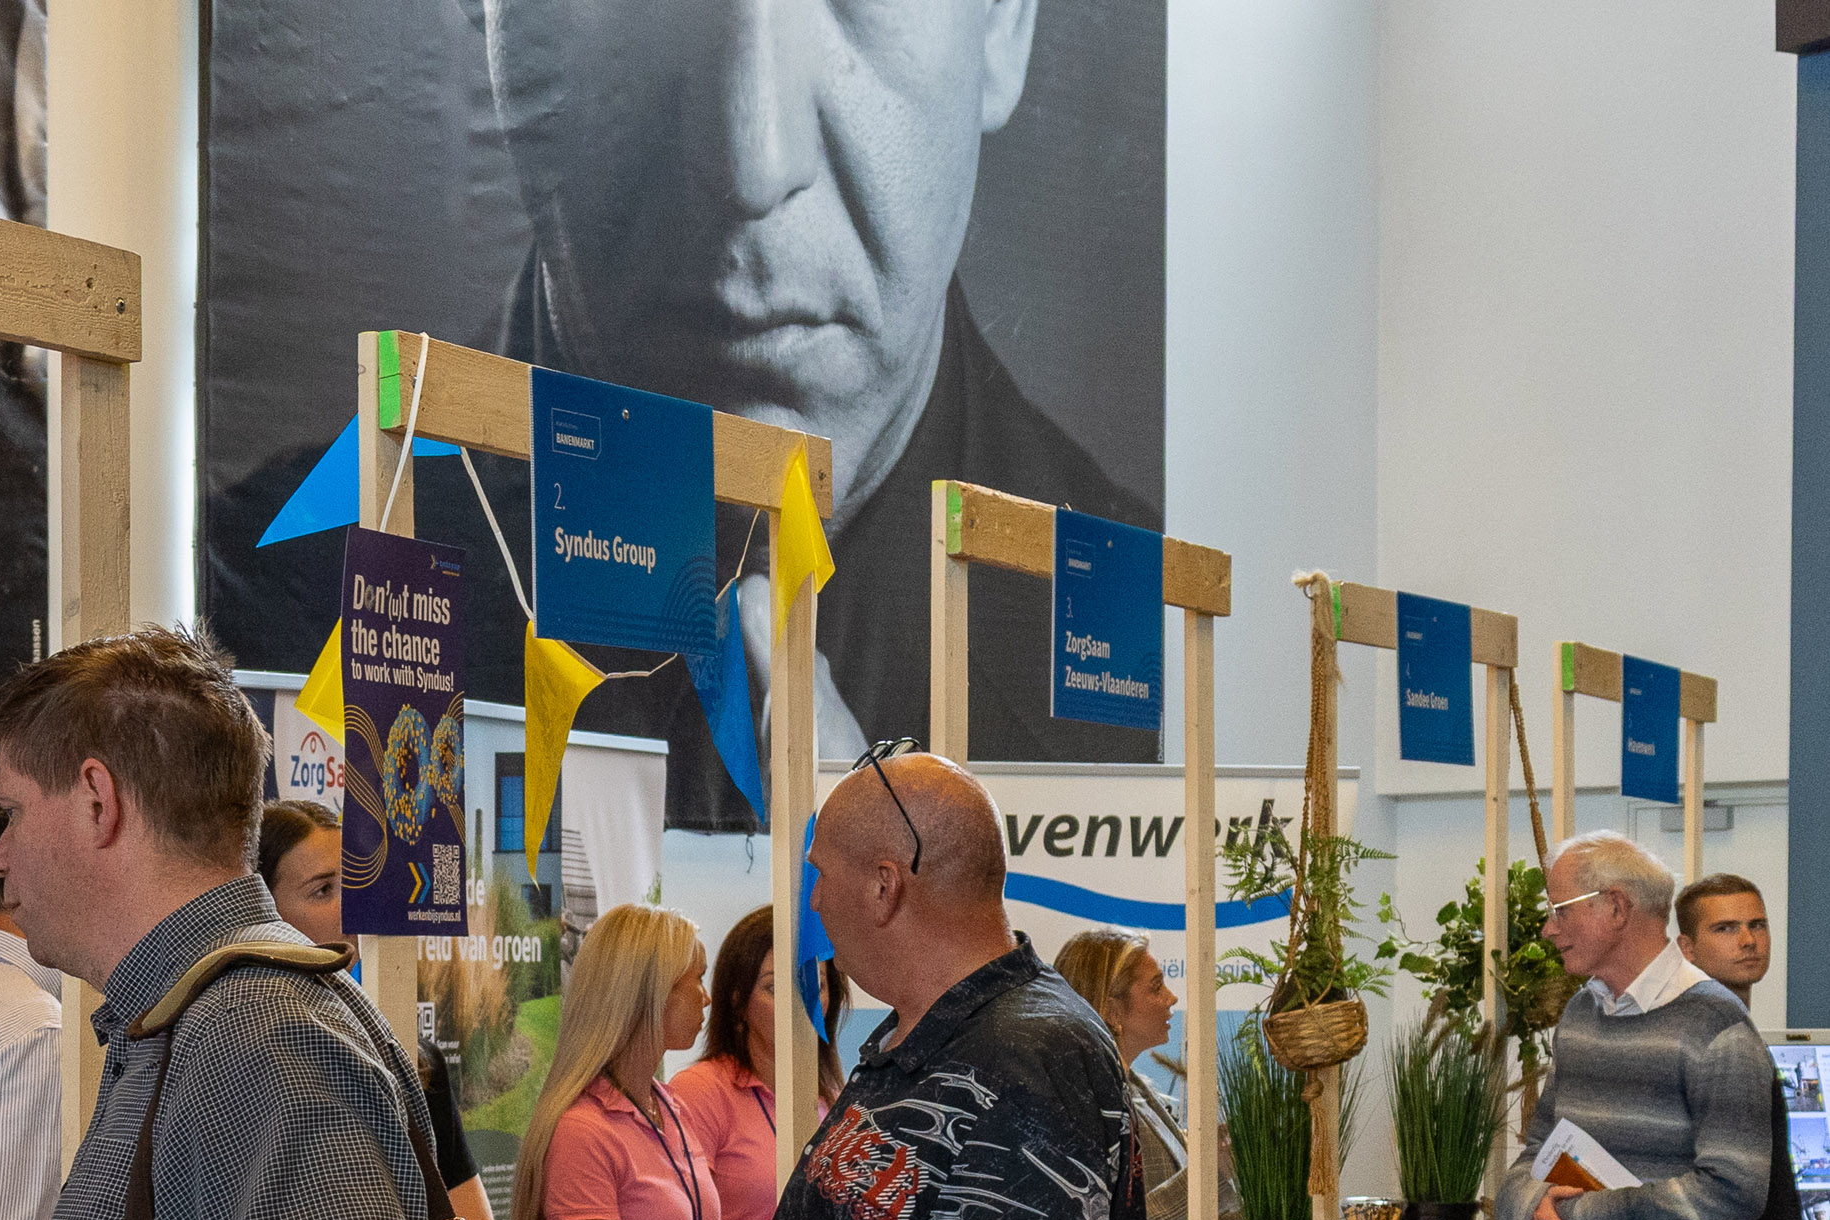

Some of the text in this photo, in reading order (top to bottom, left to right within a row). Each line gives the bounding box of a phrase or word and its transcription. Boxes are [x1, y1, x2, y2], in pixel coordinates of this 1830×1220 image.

[554, 483, 566, 510] 2.
[555, 526, 657, 574] Syndus Group
[413, 587, 451, 625] miss
[351, 619, 440, 665] the chance
[1066, 630, 1111, 661] ZorgSaam
[351, 658, 454, 693] to work with Syndus!
[1065, 665, 1150, 699] Zeeuws-Vlaanderen
[1005, 799, 1294, 857] venwrk
[492, 935, 542, 970] groen
